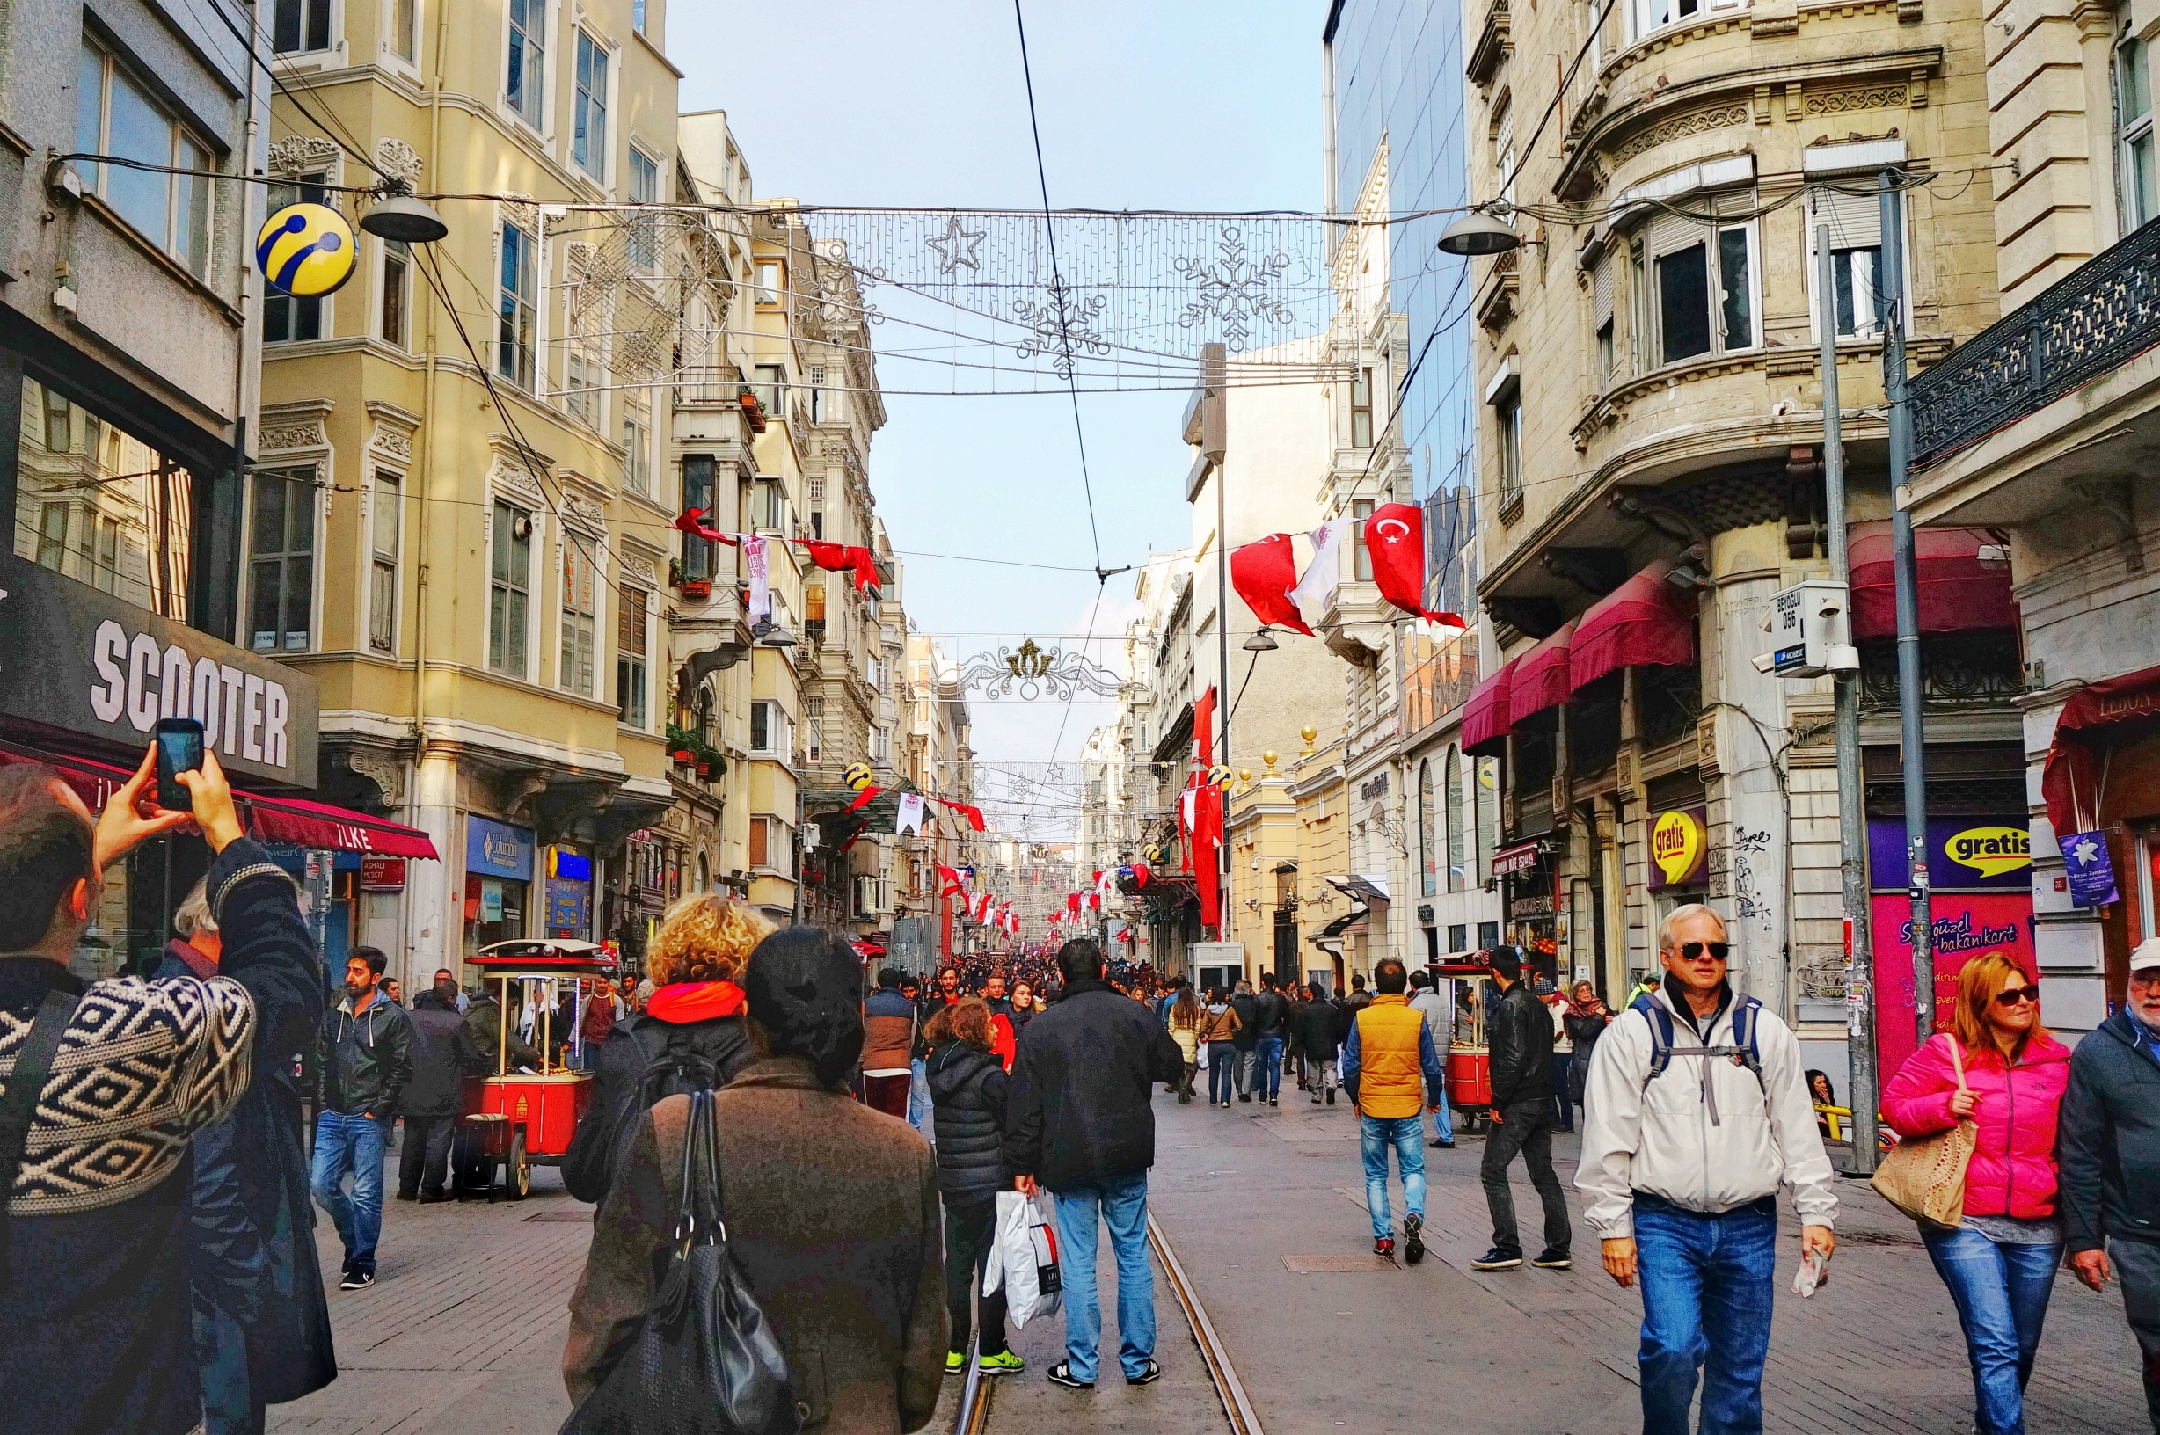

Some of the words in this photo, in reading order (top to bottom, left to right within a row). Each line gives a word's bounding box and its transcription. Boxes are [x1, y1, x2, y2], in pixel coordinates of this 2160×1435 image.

[90, 619, 289, 768] SCOOTER
[1655, 817, 1685, 860] gratis
[1955, 832, 2031, 860] gratis
[1984, 926, 2015, 944] kart
